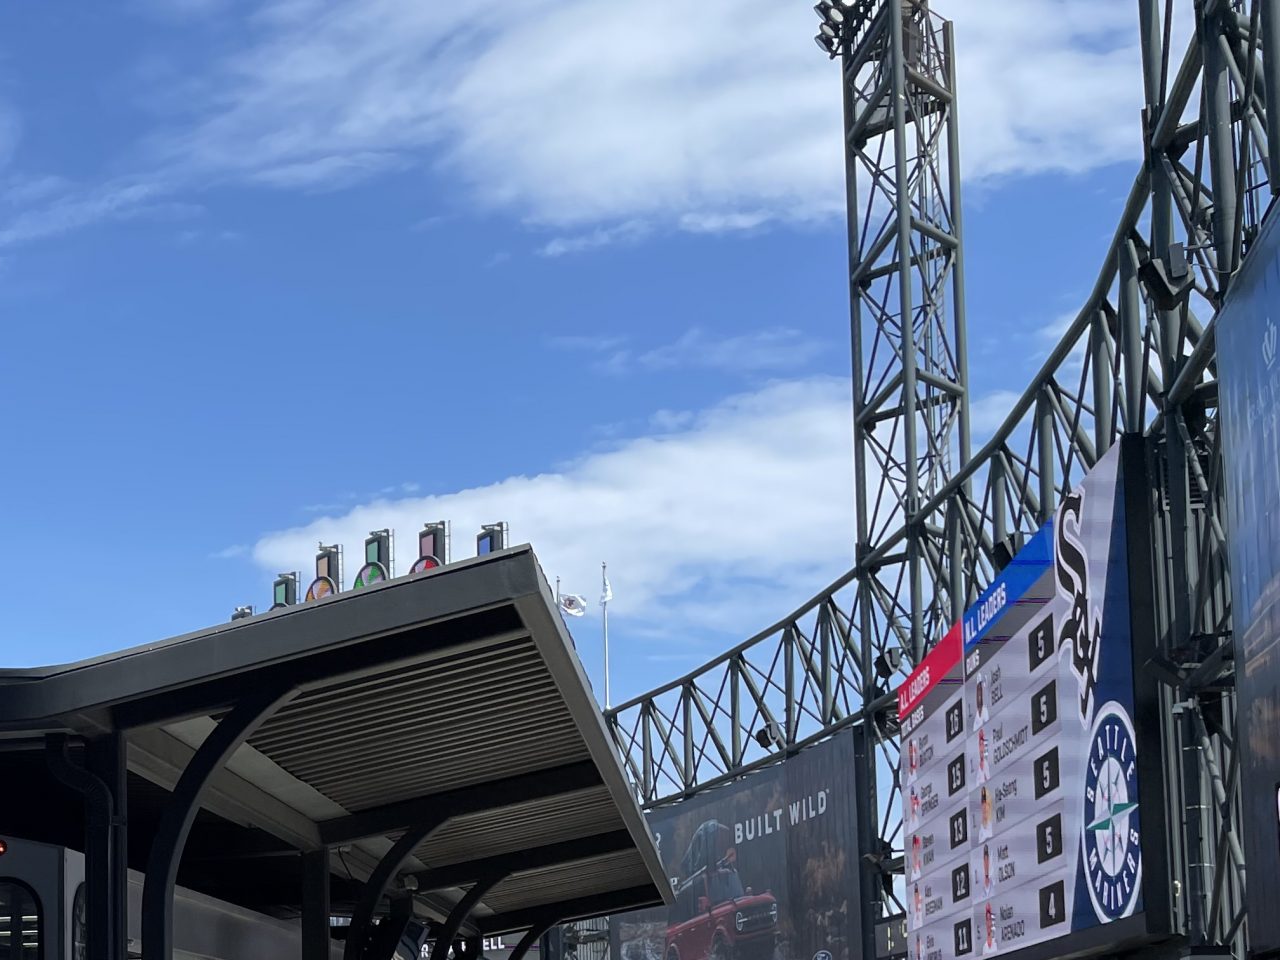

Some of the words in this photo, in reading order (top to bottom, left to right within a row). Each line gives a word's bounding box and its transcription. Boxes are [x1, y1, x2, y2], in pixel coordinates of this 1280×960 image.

[977, 585, 1007, 629] LEADERS
[1037, 632, 1045, 659] 5
[950, 709, 958, 735] 16
[1040, 696, 1047, 722] 5
[992, 727, 1028, 764] GOLDSCHMIDT
[952, 763, 961, 788] 15
[1043, 762, 1050, 789] 5
[1086, 725, 1135, 802] SEATTLE
[734, 809, 783, 845] BUILT
[789, 791, 828, 826] WILD
[953, 817, 963, 842] 13
[1046, 828, 1053, 854] 5
[1088, 828, 1139, 910] MARINERS
[956, 872, 966, 897] 12
[1048, 892, 1056, 919] 4
[958, 927, 967, 950] 11
